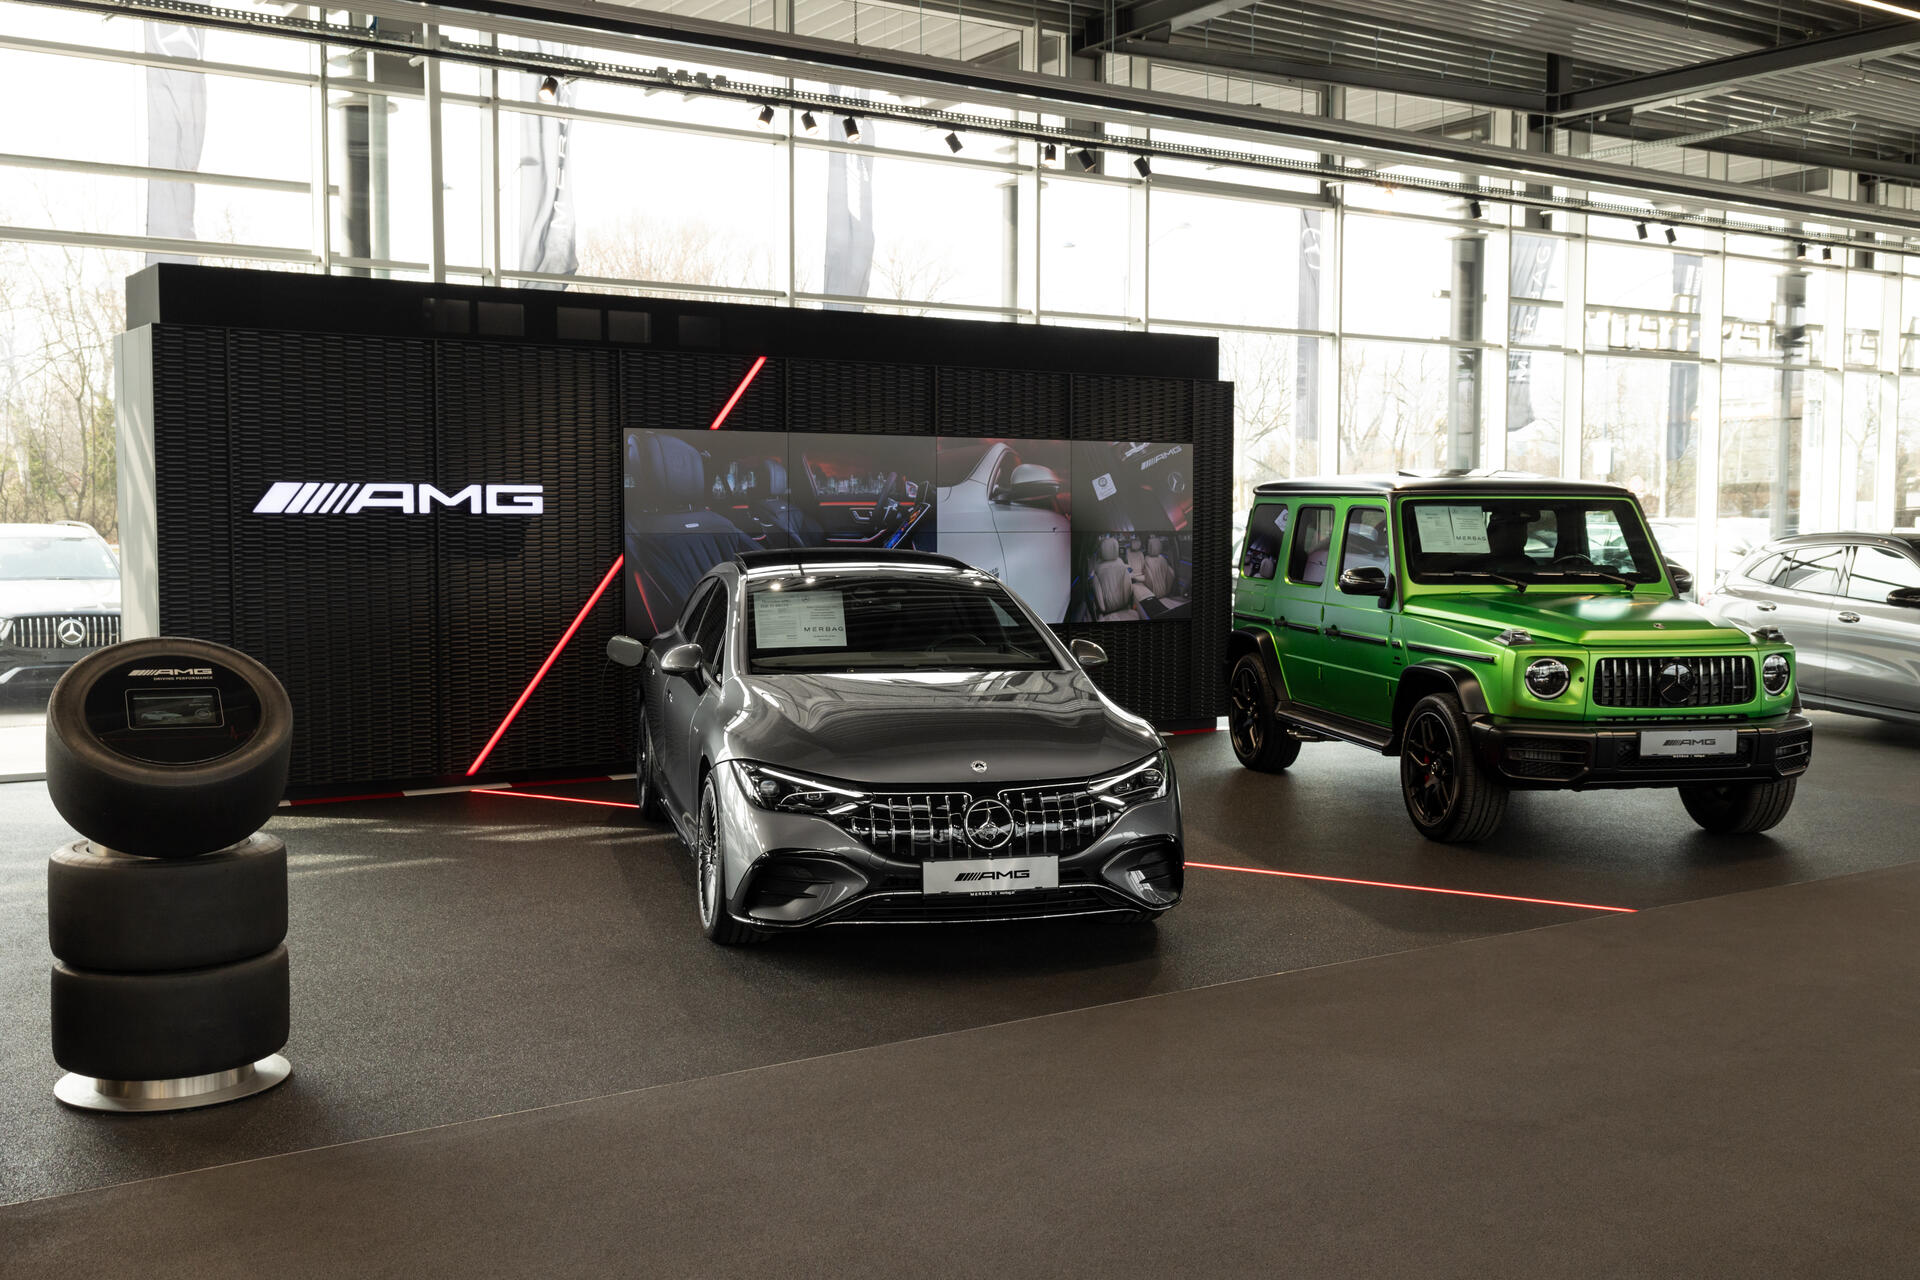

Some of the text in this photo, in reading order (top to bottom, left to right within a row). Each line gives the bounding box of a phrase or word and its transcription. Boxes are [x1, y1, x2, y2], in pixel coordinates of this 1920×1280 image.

[344, 483, 544, 515] AMG
[152, 667, 213, 677] AMG
[1678, 738, 1717, 746] AMG
[976, 869, 1031, 882] AMG
